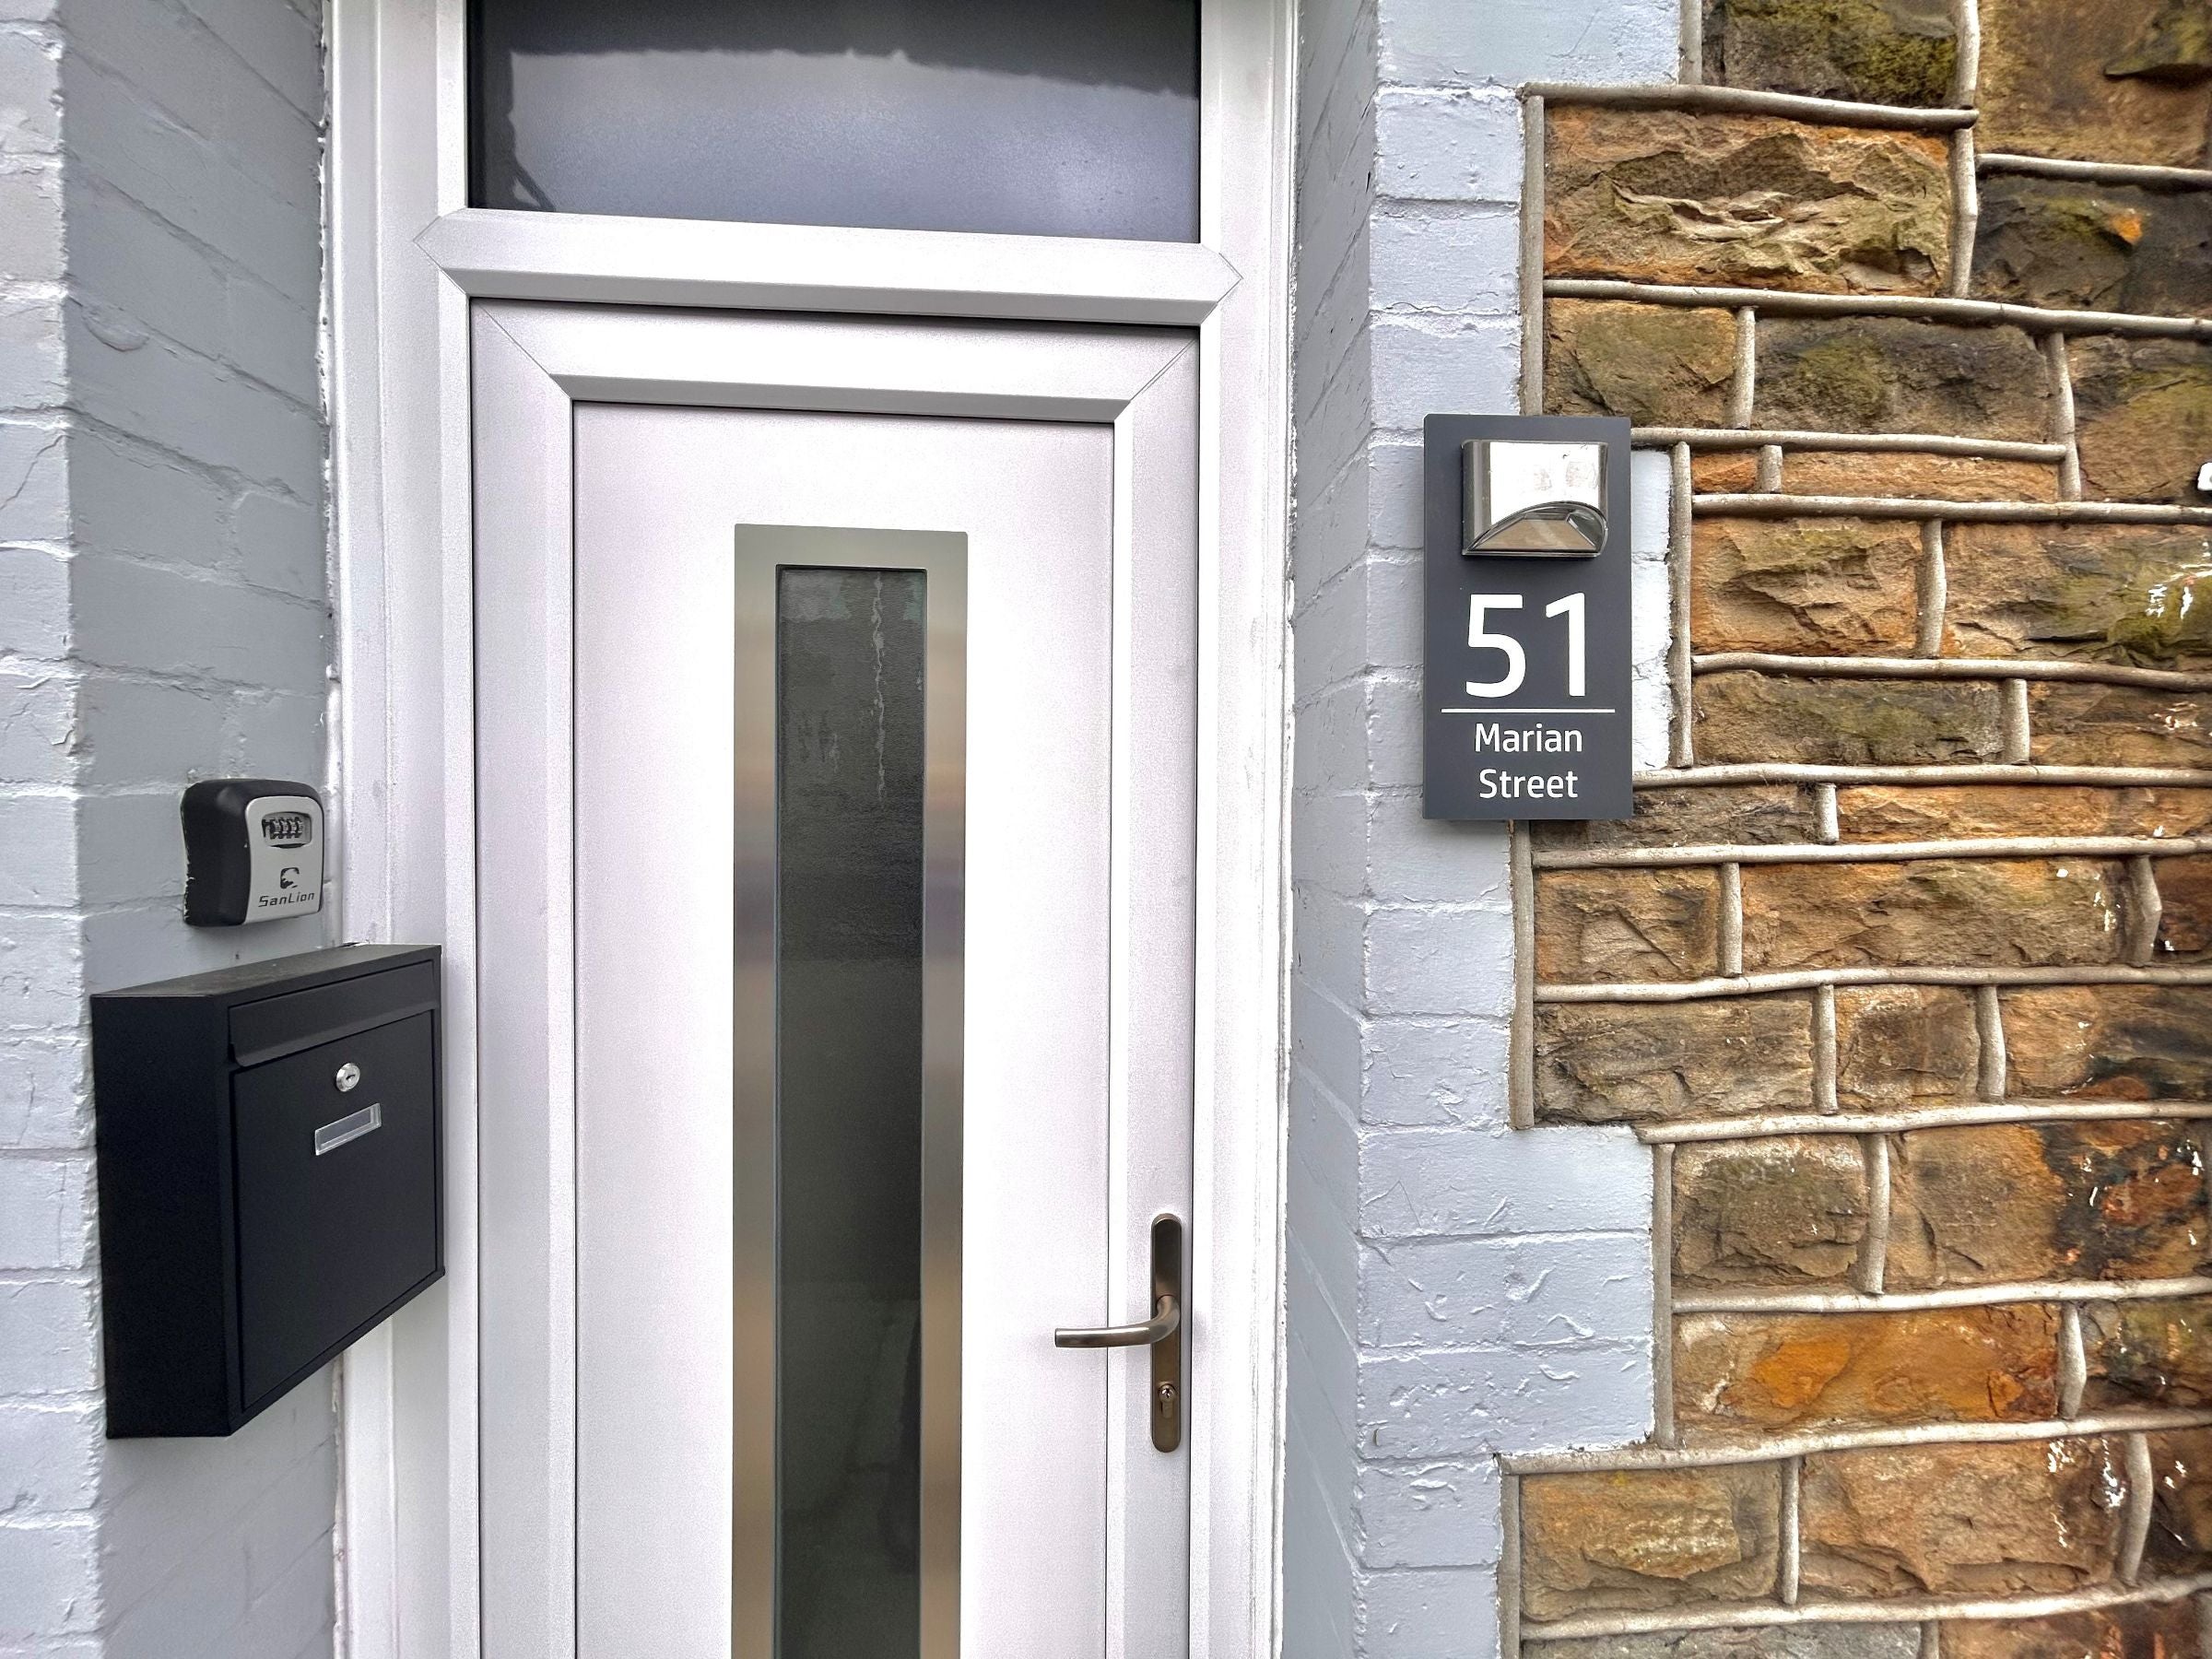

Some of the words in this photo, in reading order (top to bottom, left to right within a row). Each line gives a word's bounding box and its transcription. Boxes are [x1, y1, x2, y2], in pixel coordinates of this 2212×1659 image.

[1465, 593, 1585, 698] 51
[1475, 723, 1583, 752] Marian
[1479, 769, 1578, 799] Street
[258, 891, 314, 908] SanLion
